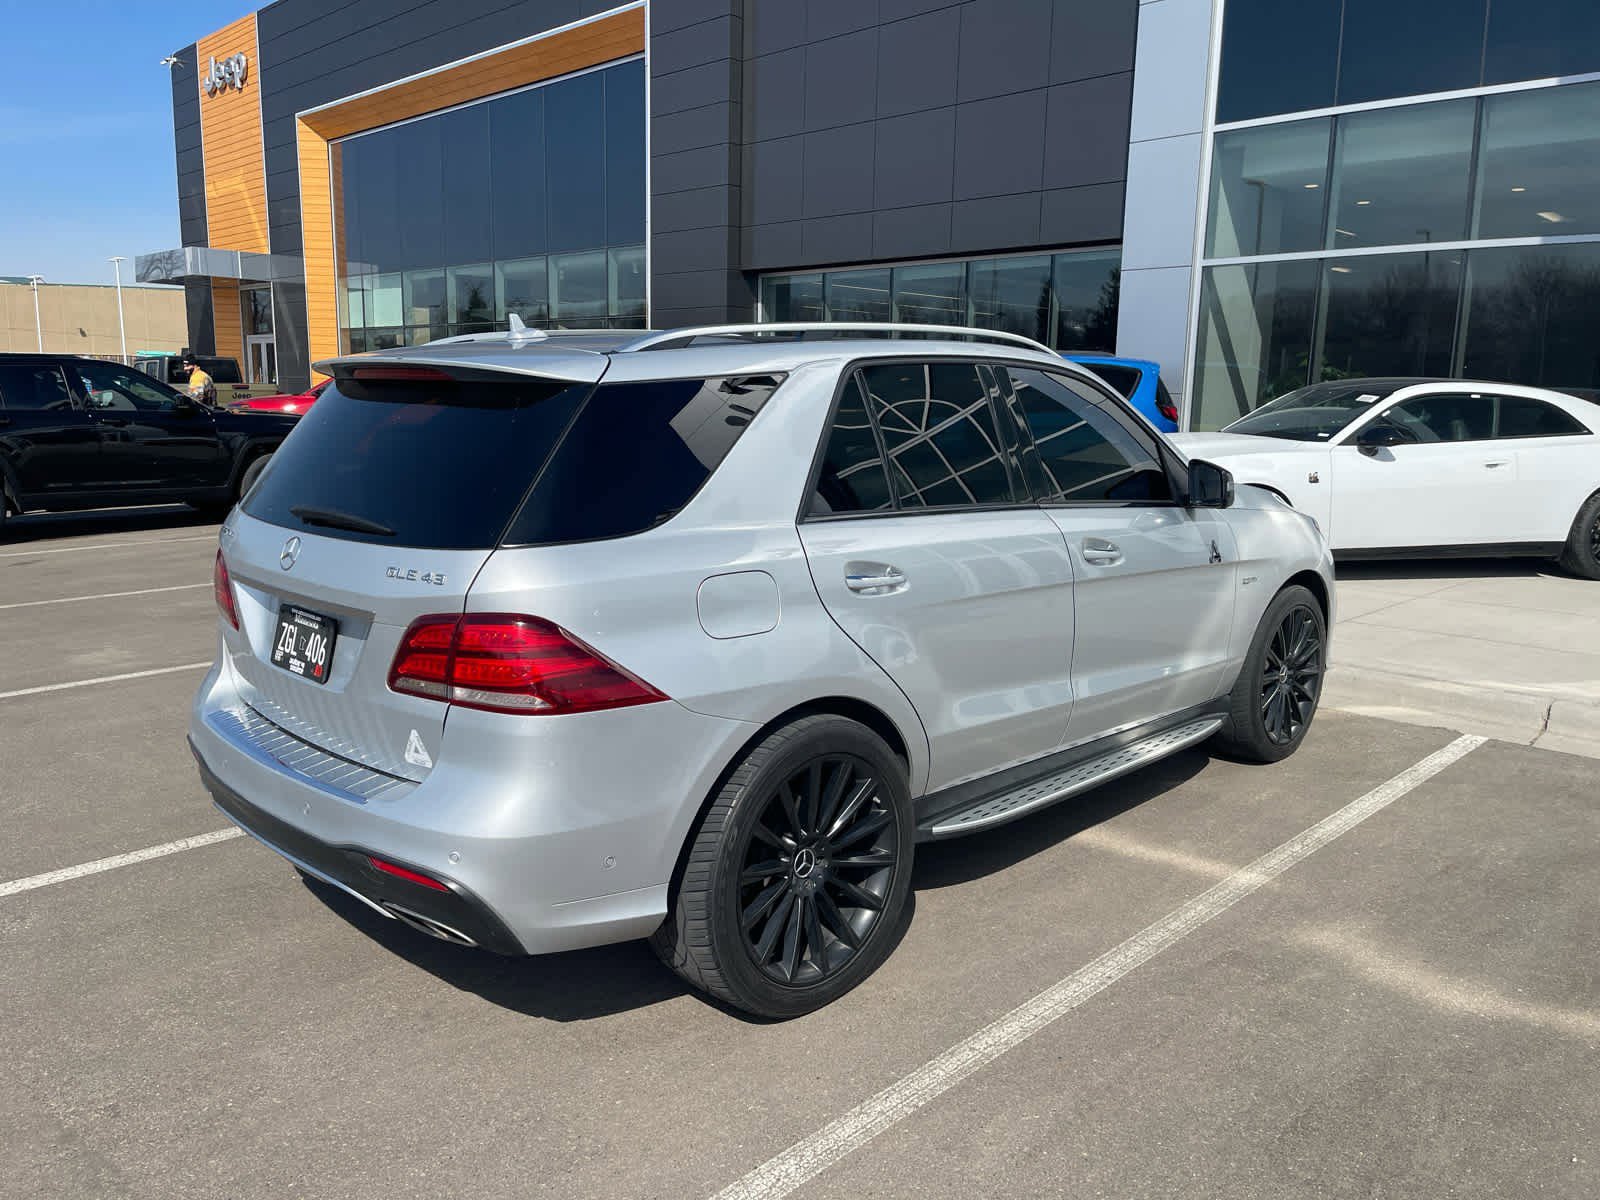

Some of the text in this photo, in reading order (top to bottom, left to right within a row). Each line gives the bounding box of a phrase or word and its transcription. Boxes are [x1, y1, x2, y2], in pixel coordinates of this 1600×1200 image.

[204, 51, 247, 93] Jeep
[386, 566, 446, 586] GLE 43
[278, 622, 327, 666] ZGL 406
